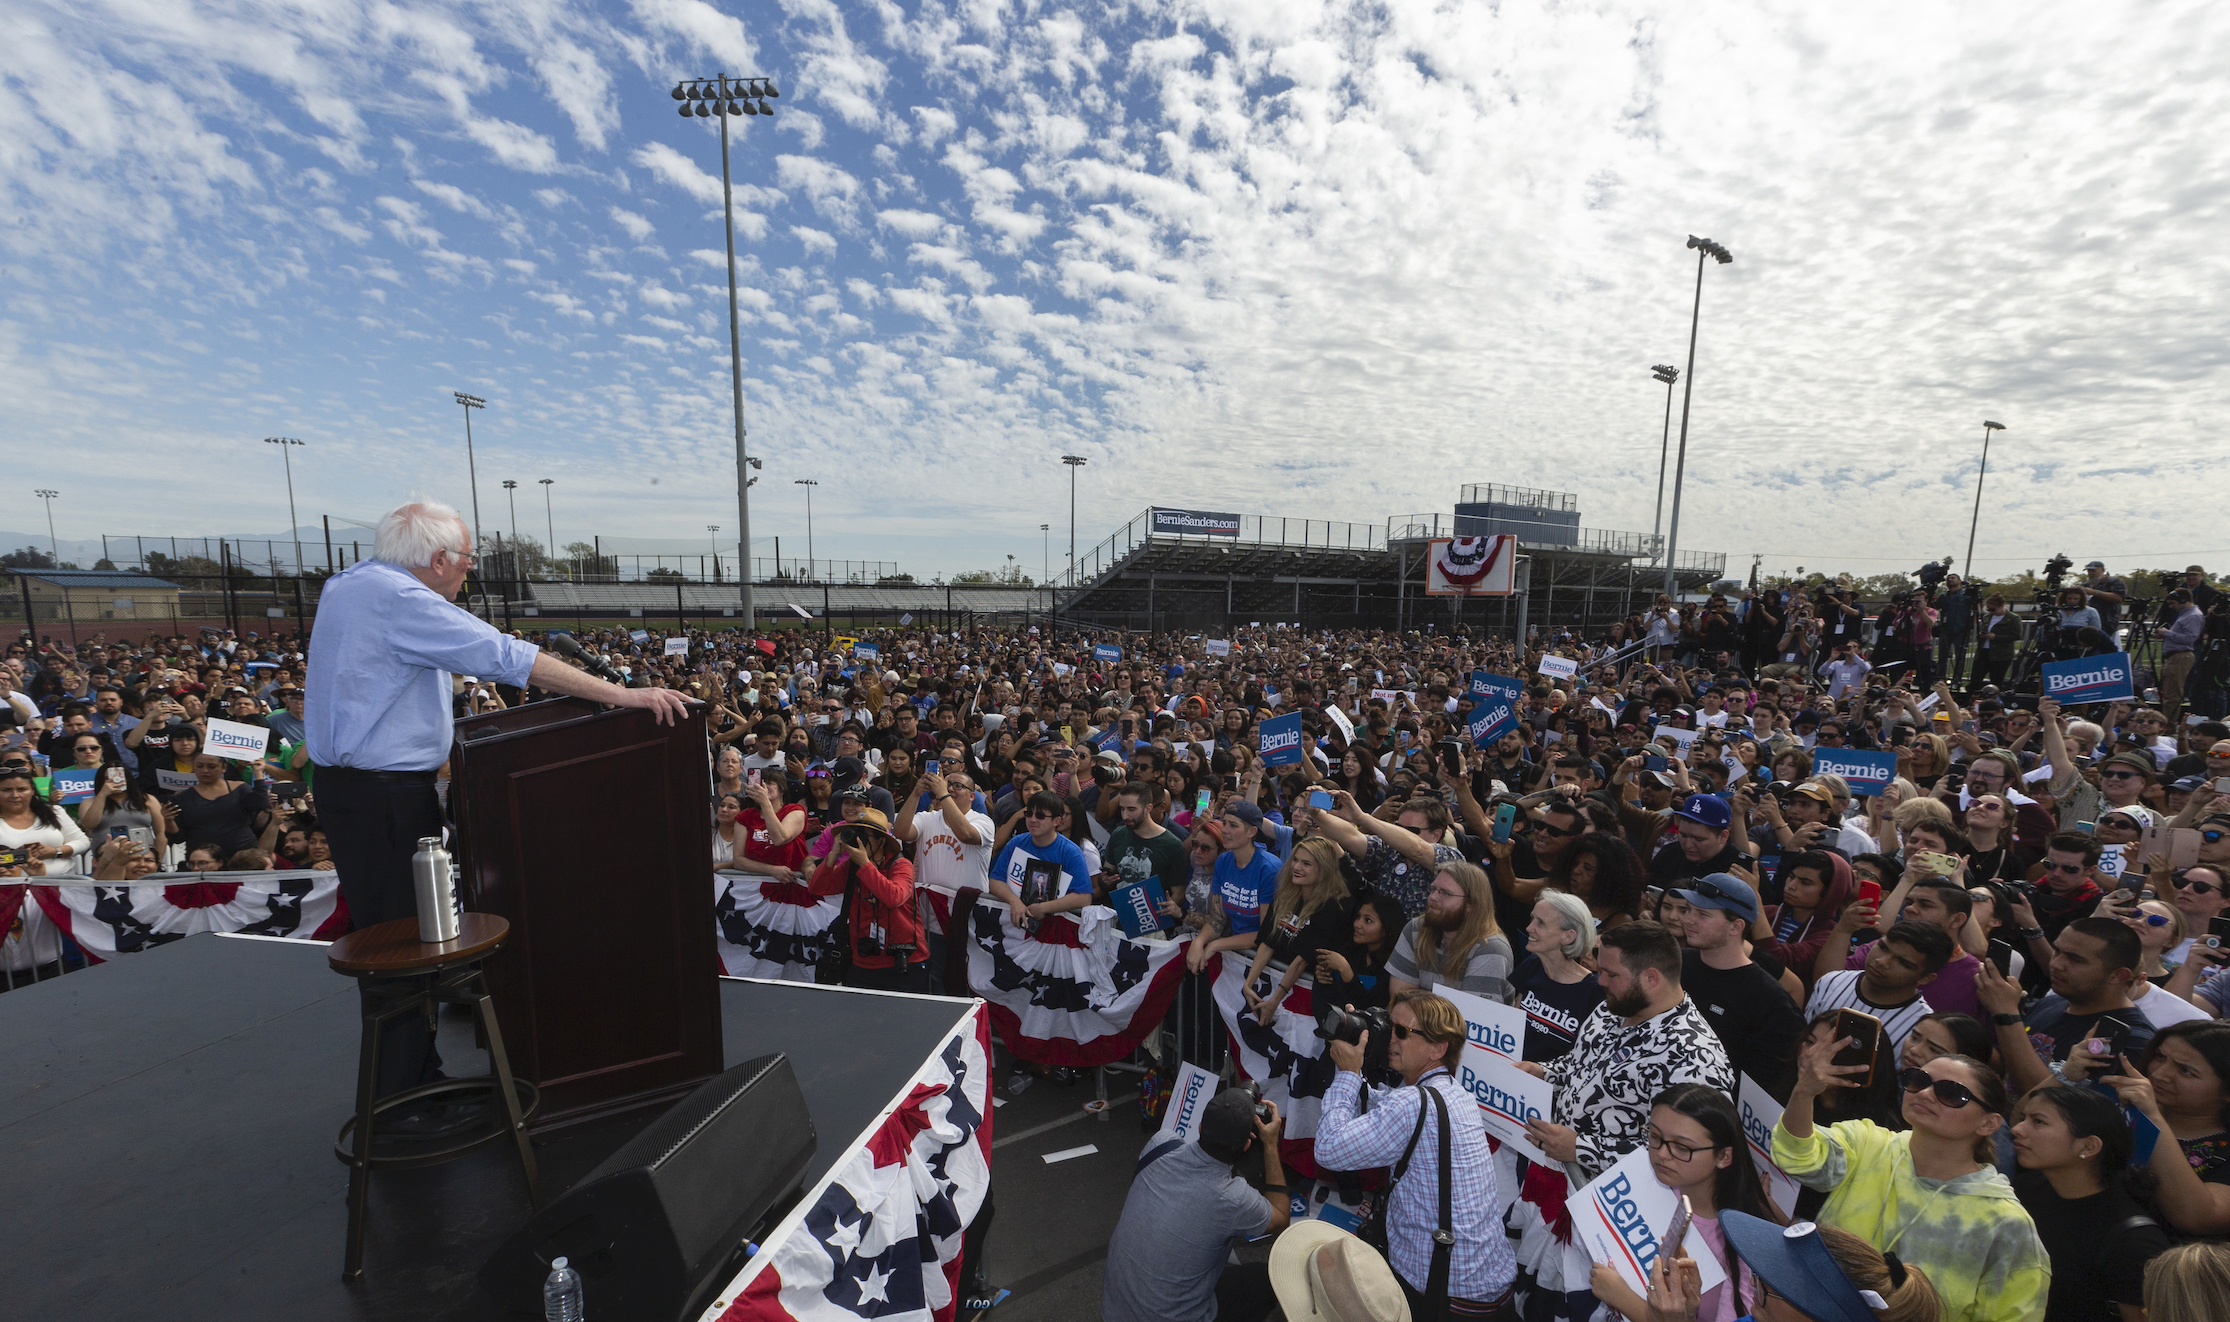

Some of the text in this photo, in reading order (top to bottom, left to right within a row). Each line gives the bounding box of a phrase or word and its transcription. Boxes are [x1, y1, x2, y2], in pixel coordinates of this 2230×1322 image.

[1156, 513, 1238, 529] BernieSanders.com
[1096, 648, 1119, 657] Bernie
[1208, 643, 1228, 651] Bernie
[1543, 660, 1573, 674] Bernie
[2048, 666, 2125, 691] Bernie
[1471, 705, 1509, 737] Bernie
[211, 728, 263, 750] Bernie
[1261, 728, 1299, 751] Bernie
[1817, 759, 1890, 781] Bernie
[60, 779, 95, 792] Ber
[1691, 799, 1702, 814] LA
[1128, 886, 1157, 934] Bernie
[1520, 990, 1579, 1033] Bernie
[1465, 1020, 1516, 1054] rnie
[1530, 1020, 1549, 1035] 2020
[1175, 1072, 1206, 1138] Bernie
[1742, 1100, 1772, 1152] Ber
[1599, 1171, 1660, 1271] Bern
